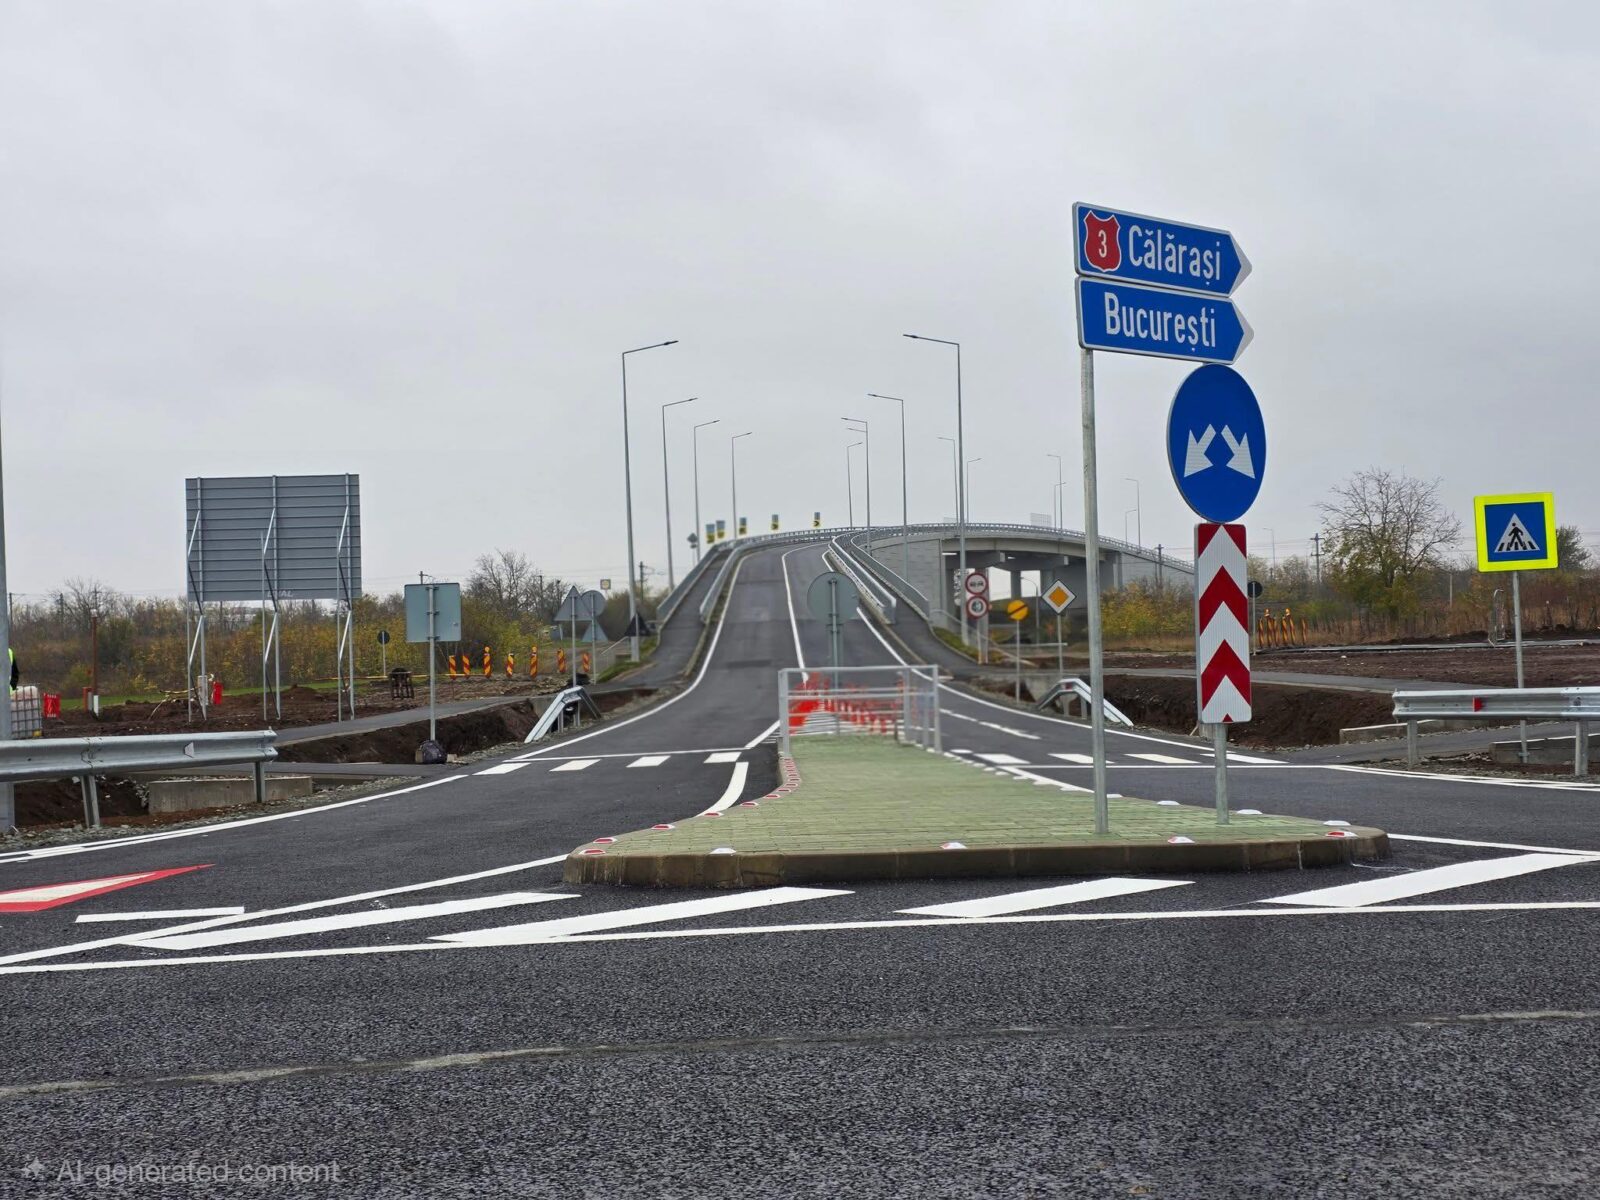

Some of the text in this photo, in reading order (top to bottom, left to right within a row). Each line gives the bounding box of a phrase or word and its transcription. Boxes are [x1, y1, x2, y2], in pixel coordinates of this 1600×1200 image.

[1098, 224, 1220, 286] 3 Călărași
[1104, 291, 1216, 352] București
